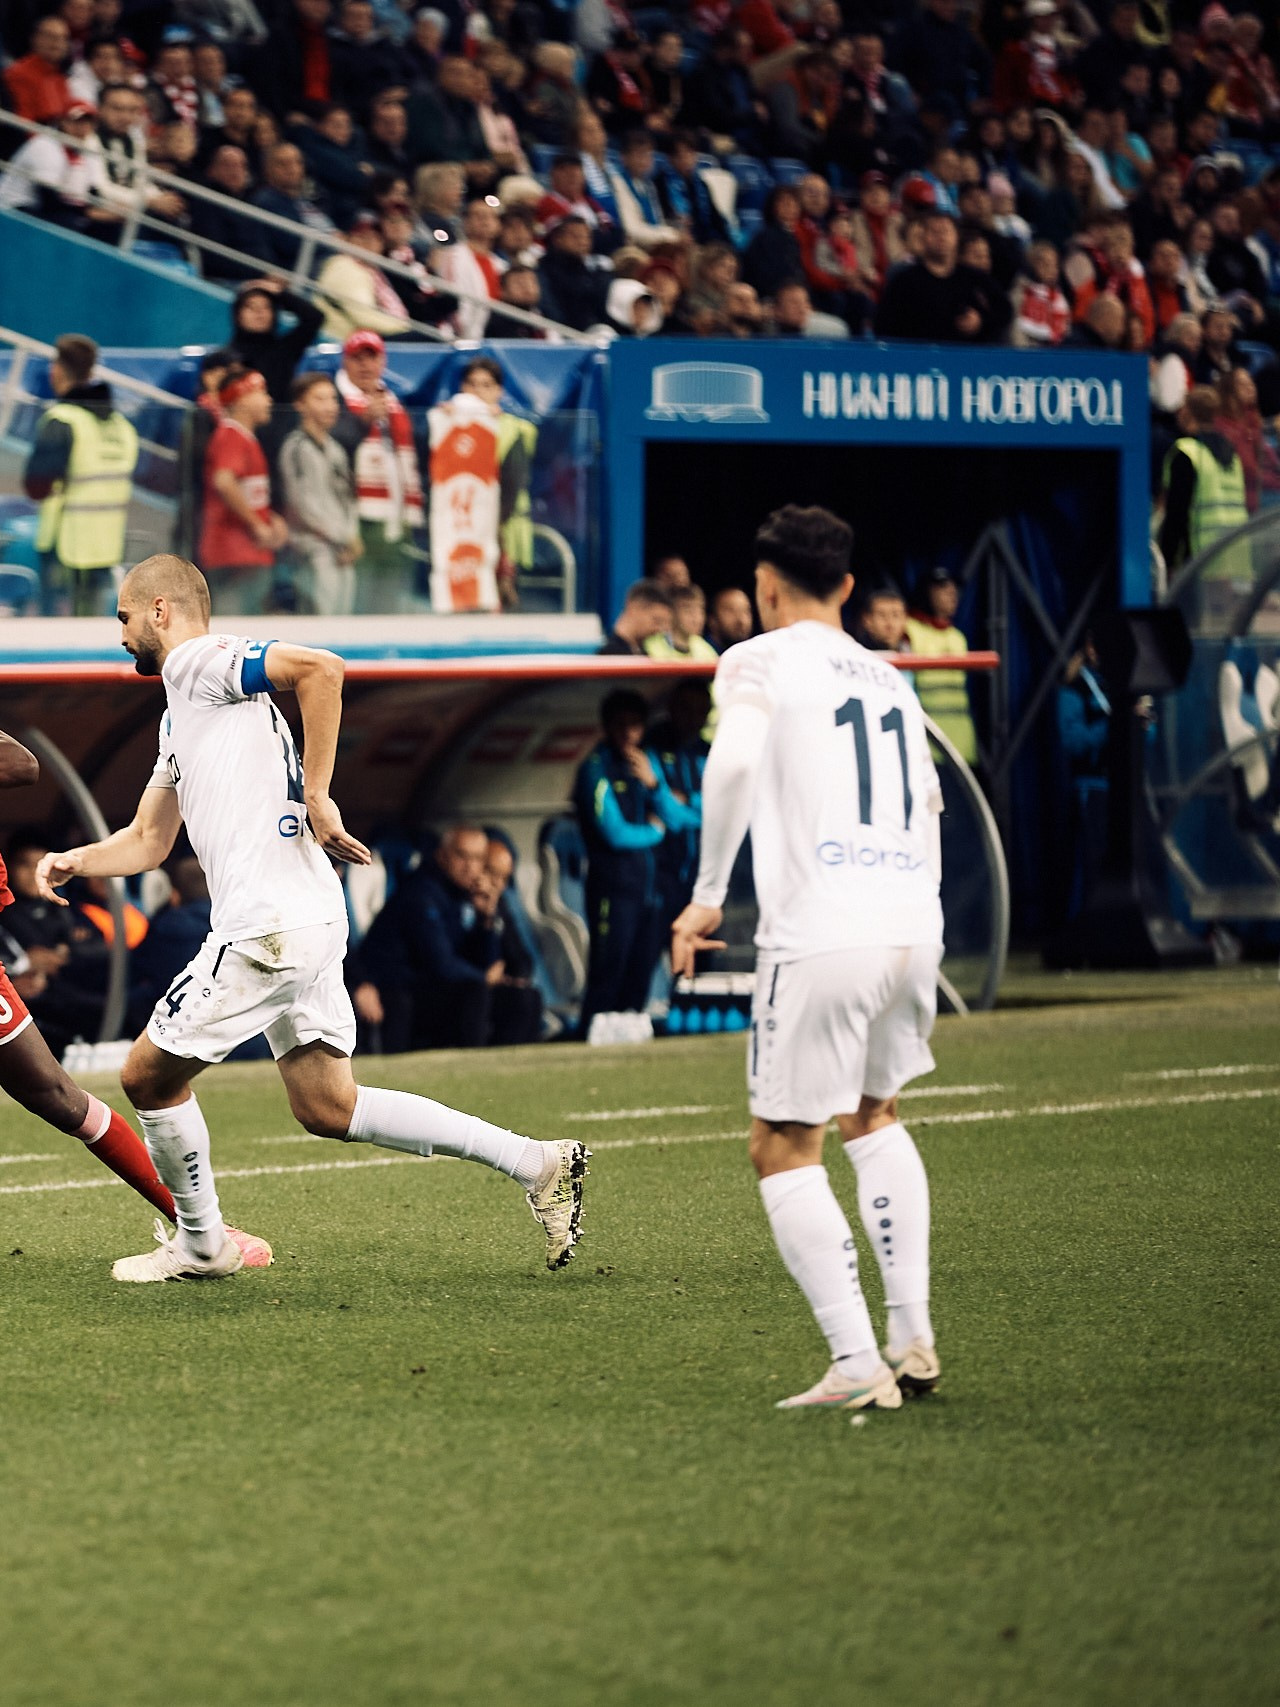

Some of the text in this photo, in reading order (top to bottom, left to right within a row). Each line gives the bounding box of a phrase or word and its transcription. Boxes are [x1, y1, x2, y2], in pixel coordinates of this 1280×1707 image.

[803, 368, 1124, 425] НИЖНИЙ НОВГОРОД
[835, 697, 913, 831] 11
